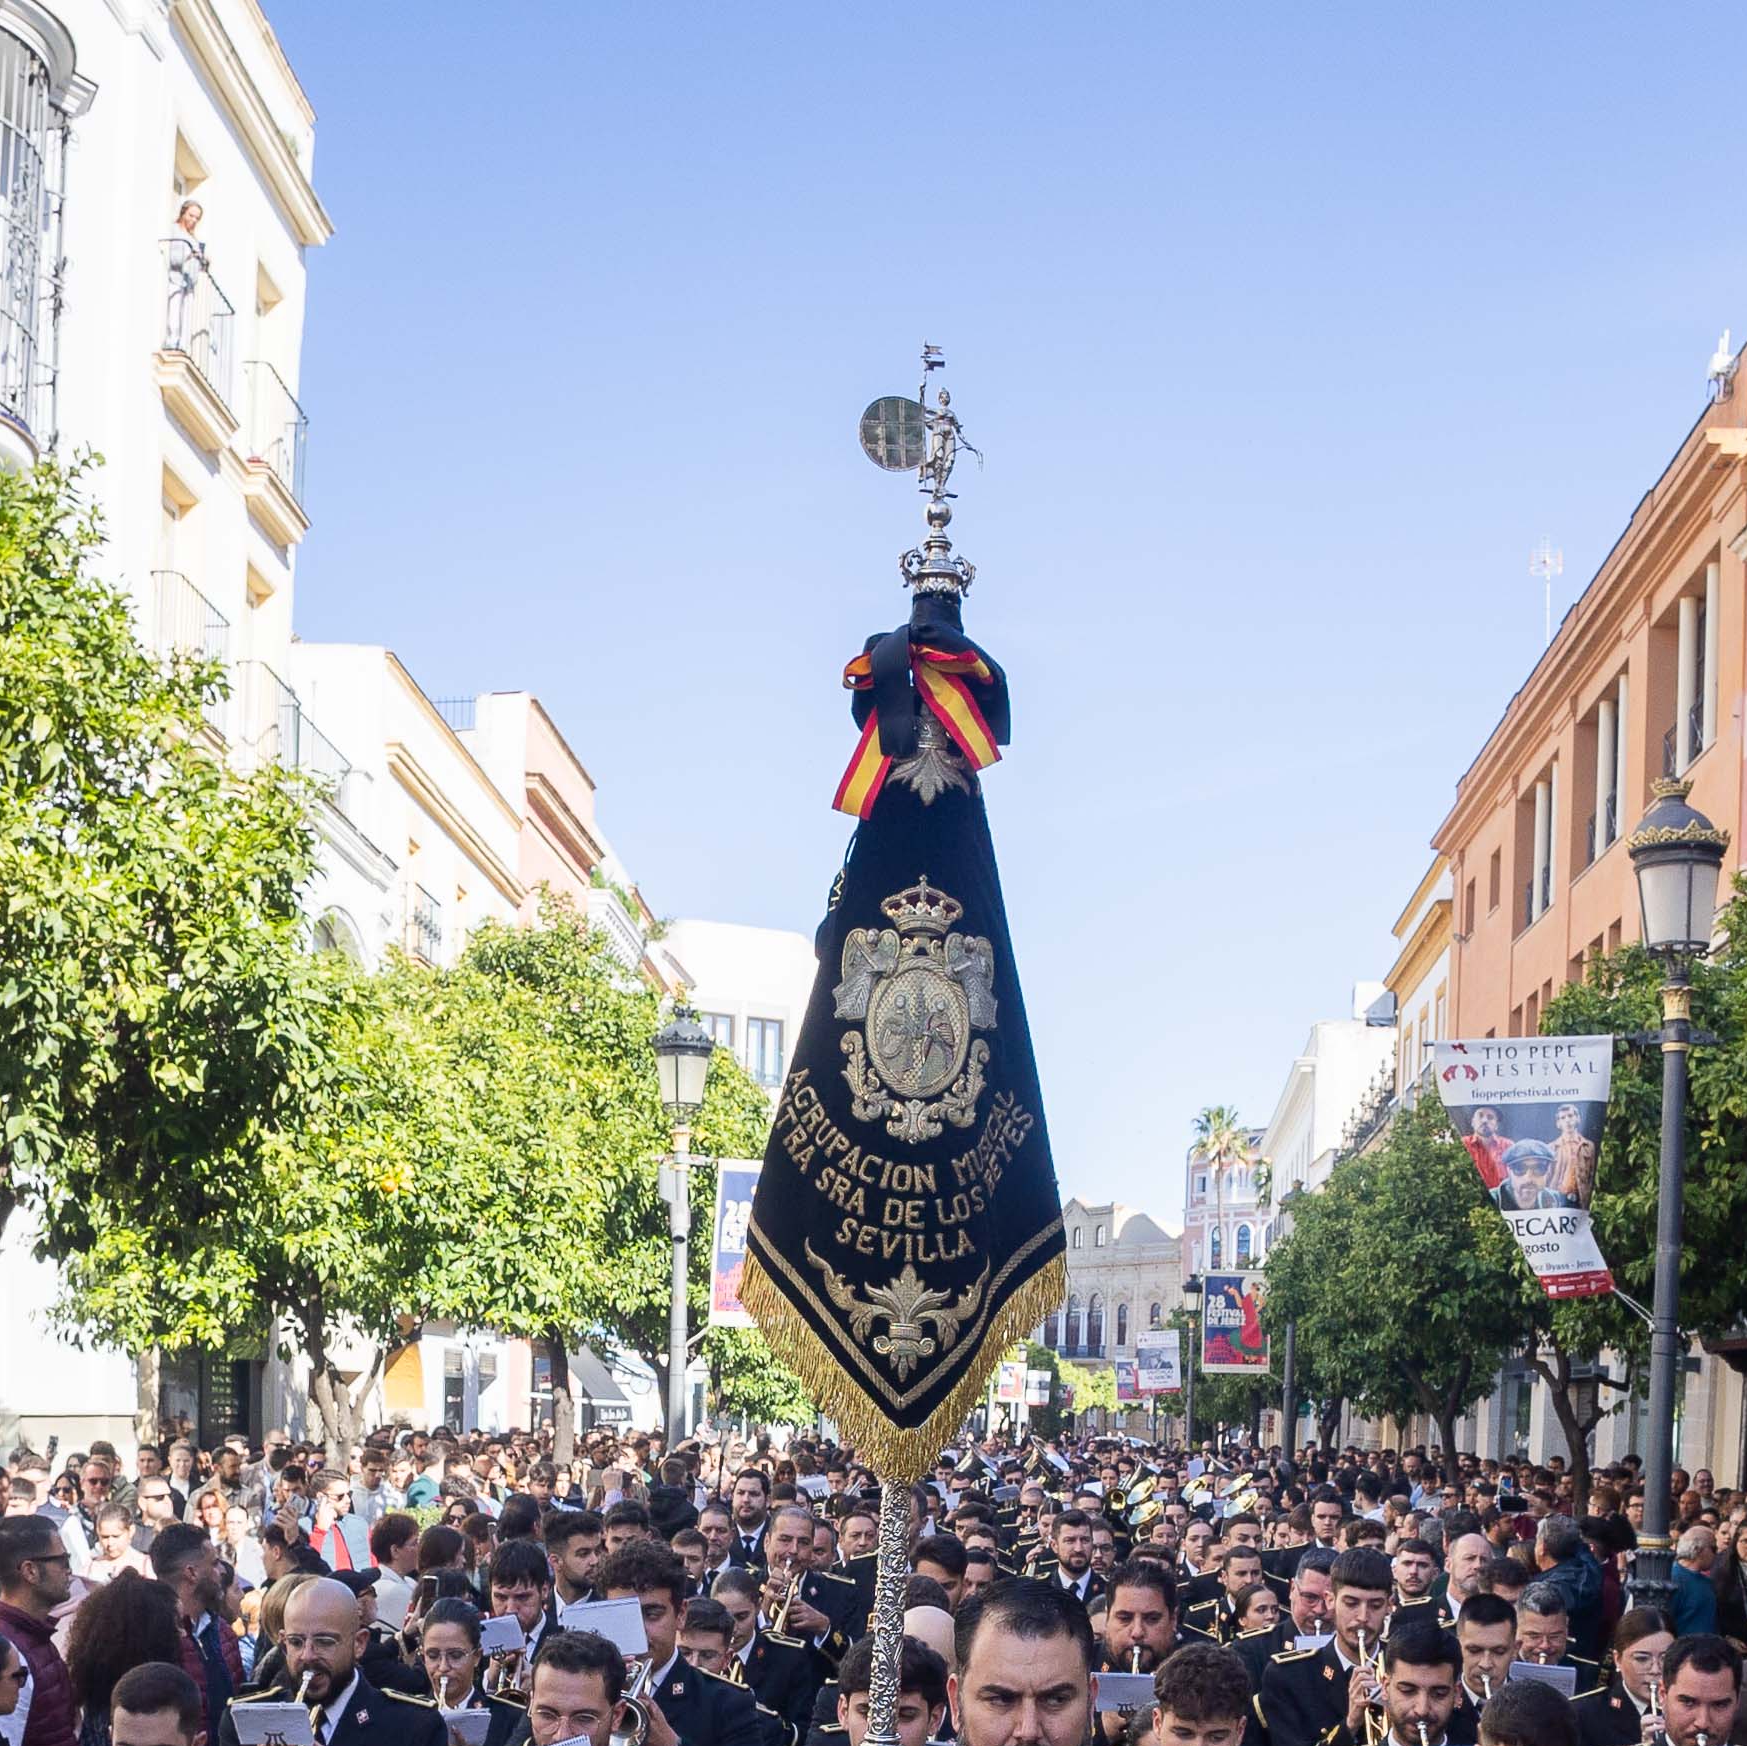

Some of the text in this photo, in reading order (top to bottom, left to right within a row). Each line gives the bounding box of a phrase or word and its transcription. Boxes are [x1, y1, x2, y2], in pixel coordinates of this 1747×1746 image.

[1482, 1044, 1577, 1060] TIO PEPE
[1471, 1086, 1580, 1101] tiopepefestival.com
[788, 1067, 936, 1195] AGRUPACION
[776, 1096, 816, 1175] TRA
[814, 1166, 866, 1217] SRA
[882, 1197, 926, 1230] DE
[935, 1185, 986, 1226] LOS
[834, 1217, 977, 1263] SEVILLA
[1519, 1241, 1561, 1257] gosto
[1207, 1294, 1226, 1309] 28
